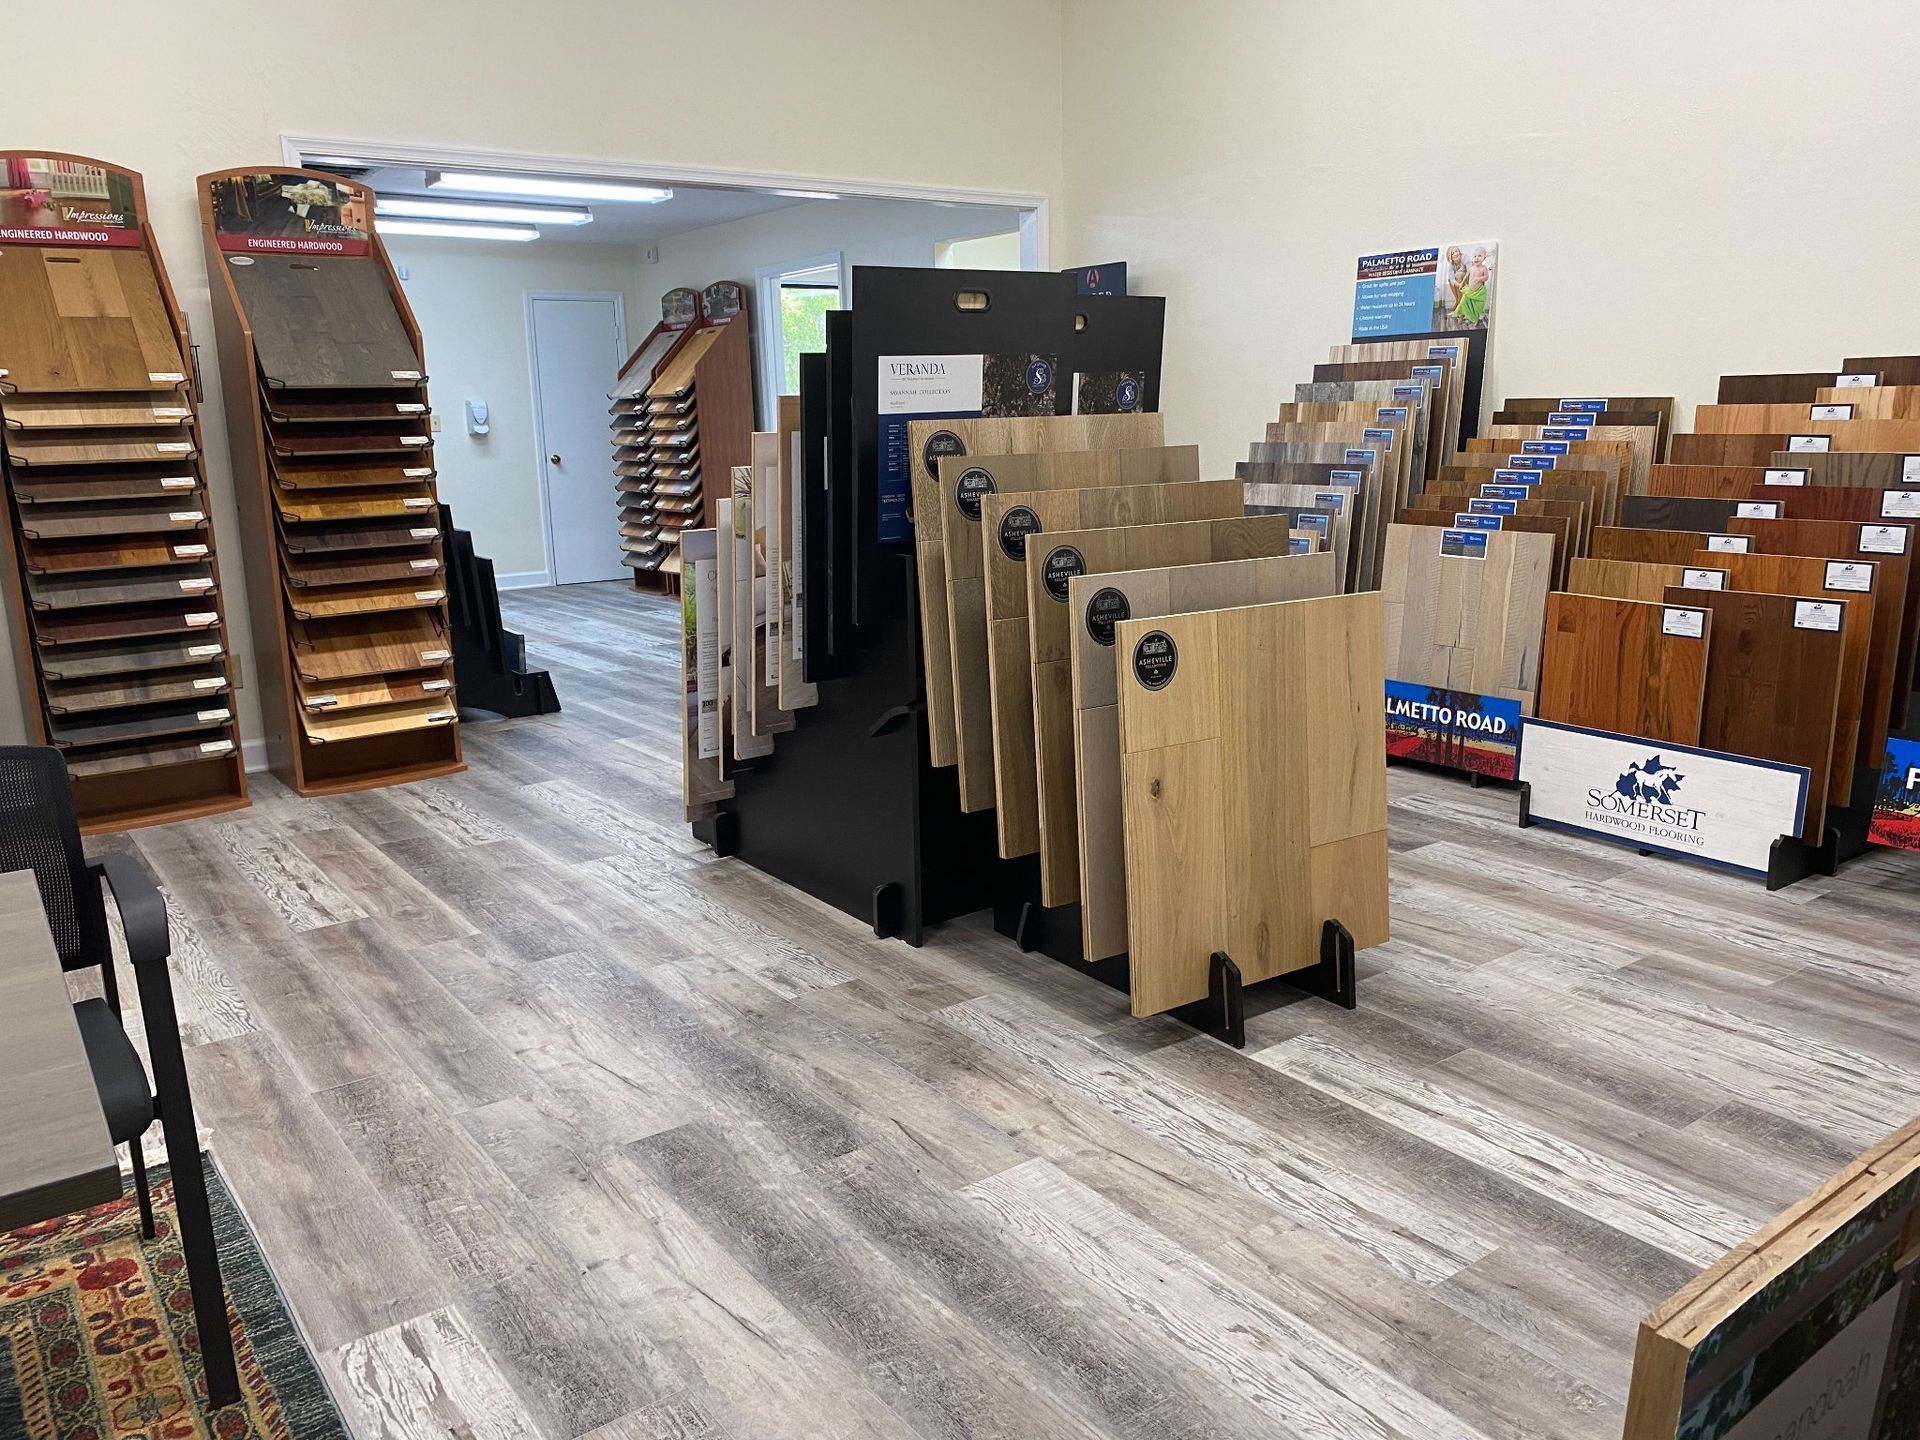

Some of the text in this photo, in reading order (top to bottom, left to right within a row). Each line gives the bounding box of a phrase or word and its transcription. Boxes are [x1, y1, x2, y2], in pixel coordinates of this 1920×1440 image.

[66, 207, 124, 222] Impressions
[309, 219, 356, 234] Impressions
[55, 230, 109, 242] HARDWOOD
[248, 239, 343, 251] ENGINEERED HARDWOOD
[1362, 253, 1432, 268] PALMETTO ROAD
[890, 363, 946, 376] VERANDA
[1047, 569, 1081, 579] ASHEVILLE
[1091, 611, 1125, 622] ASHEVILLE
[1138, 655, 1172, 666] ASHEVILLE
[1385, 697, 1506, 734] LMETTO ROAD
[1586, 788, 1706, 830] SOMERSET
[1585, 810, 1705, 847] HARDWOOD FLOORING
[1775, 1347, 1871, 1440] andoah
